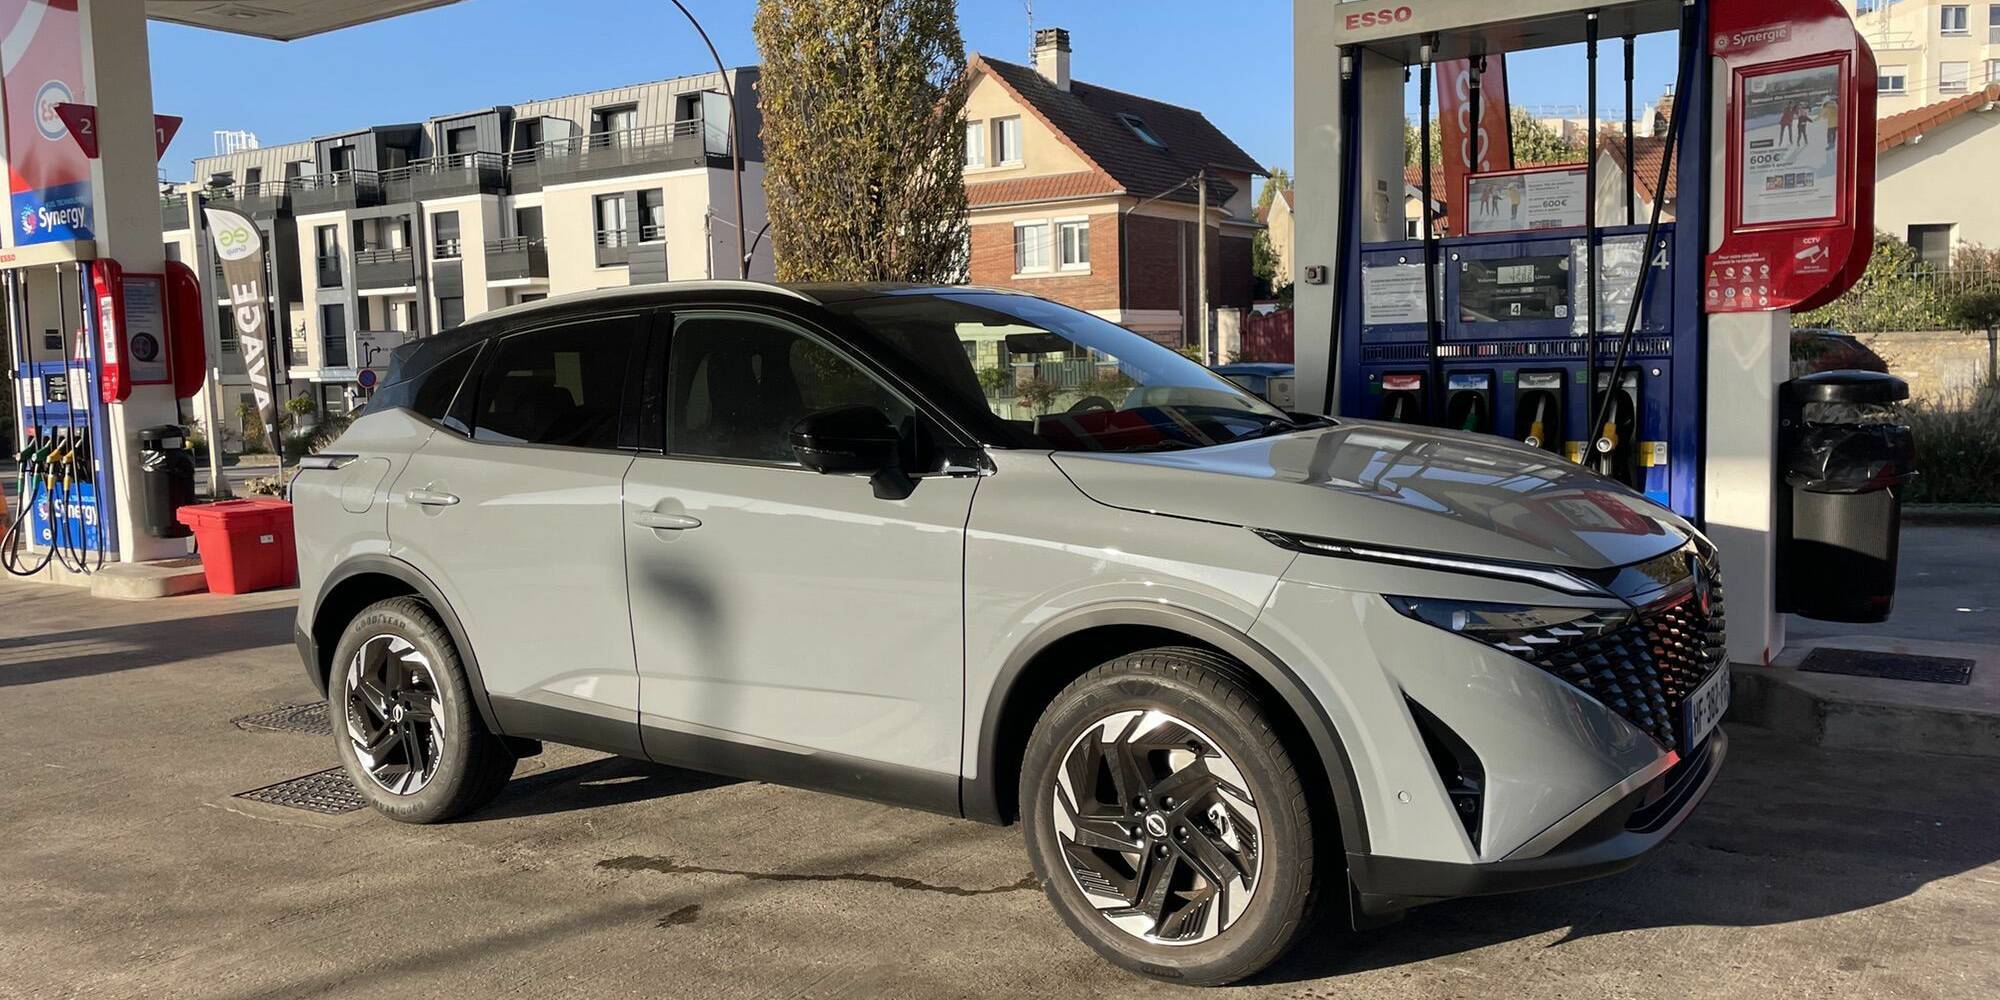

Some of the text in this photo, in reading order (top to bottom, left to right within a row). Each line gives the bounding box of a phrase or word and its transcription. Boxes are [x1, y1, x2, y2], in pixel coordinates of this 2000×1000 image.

[1345, 7, 1413, 31] ESSO
[1732, 28, 1787, 47] Synergie
[80, 118, 92, 135] 2
[156, 128, 165, 144] 1
[39, 206, 85, 232] Synergy
[1802, 236, 1821, 244] CCTV
[1651, 249, 1670, 270] 4
[1512, 304, 1520, 313] 4
[355, 613, 407, 632] GOODYEAR
